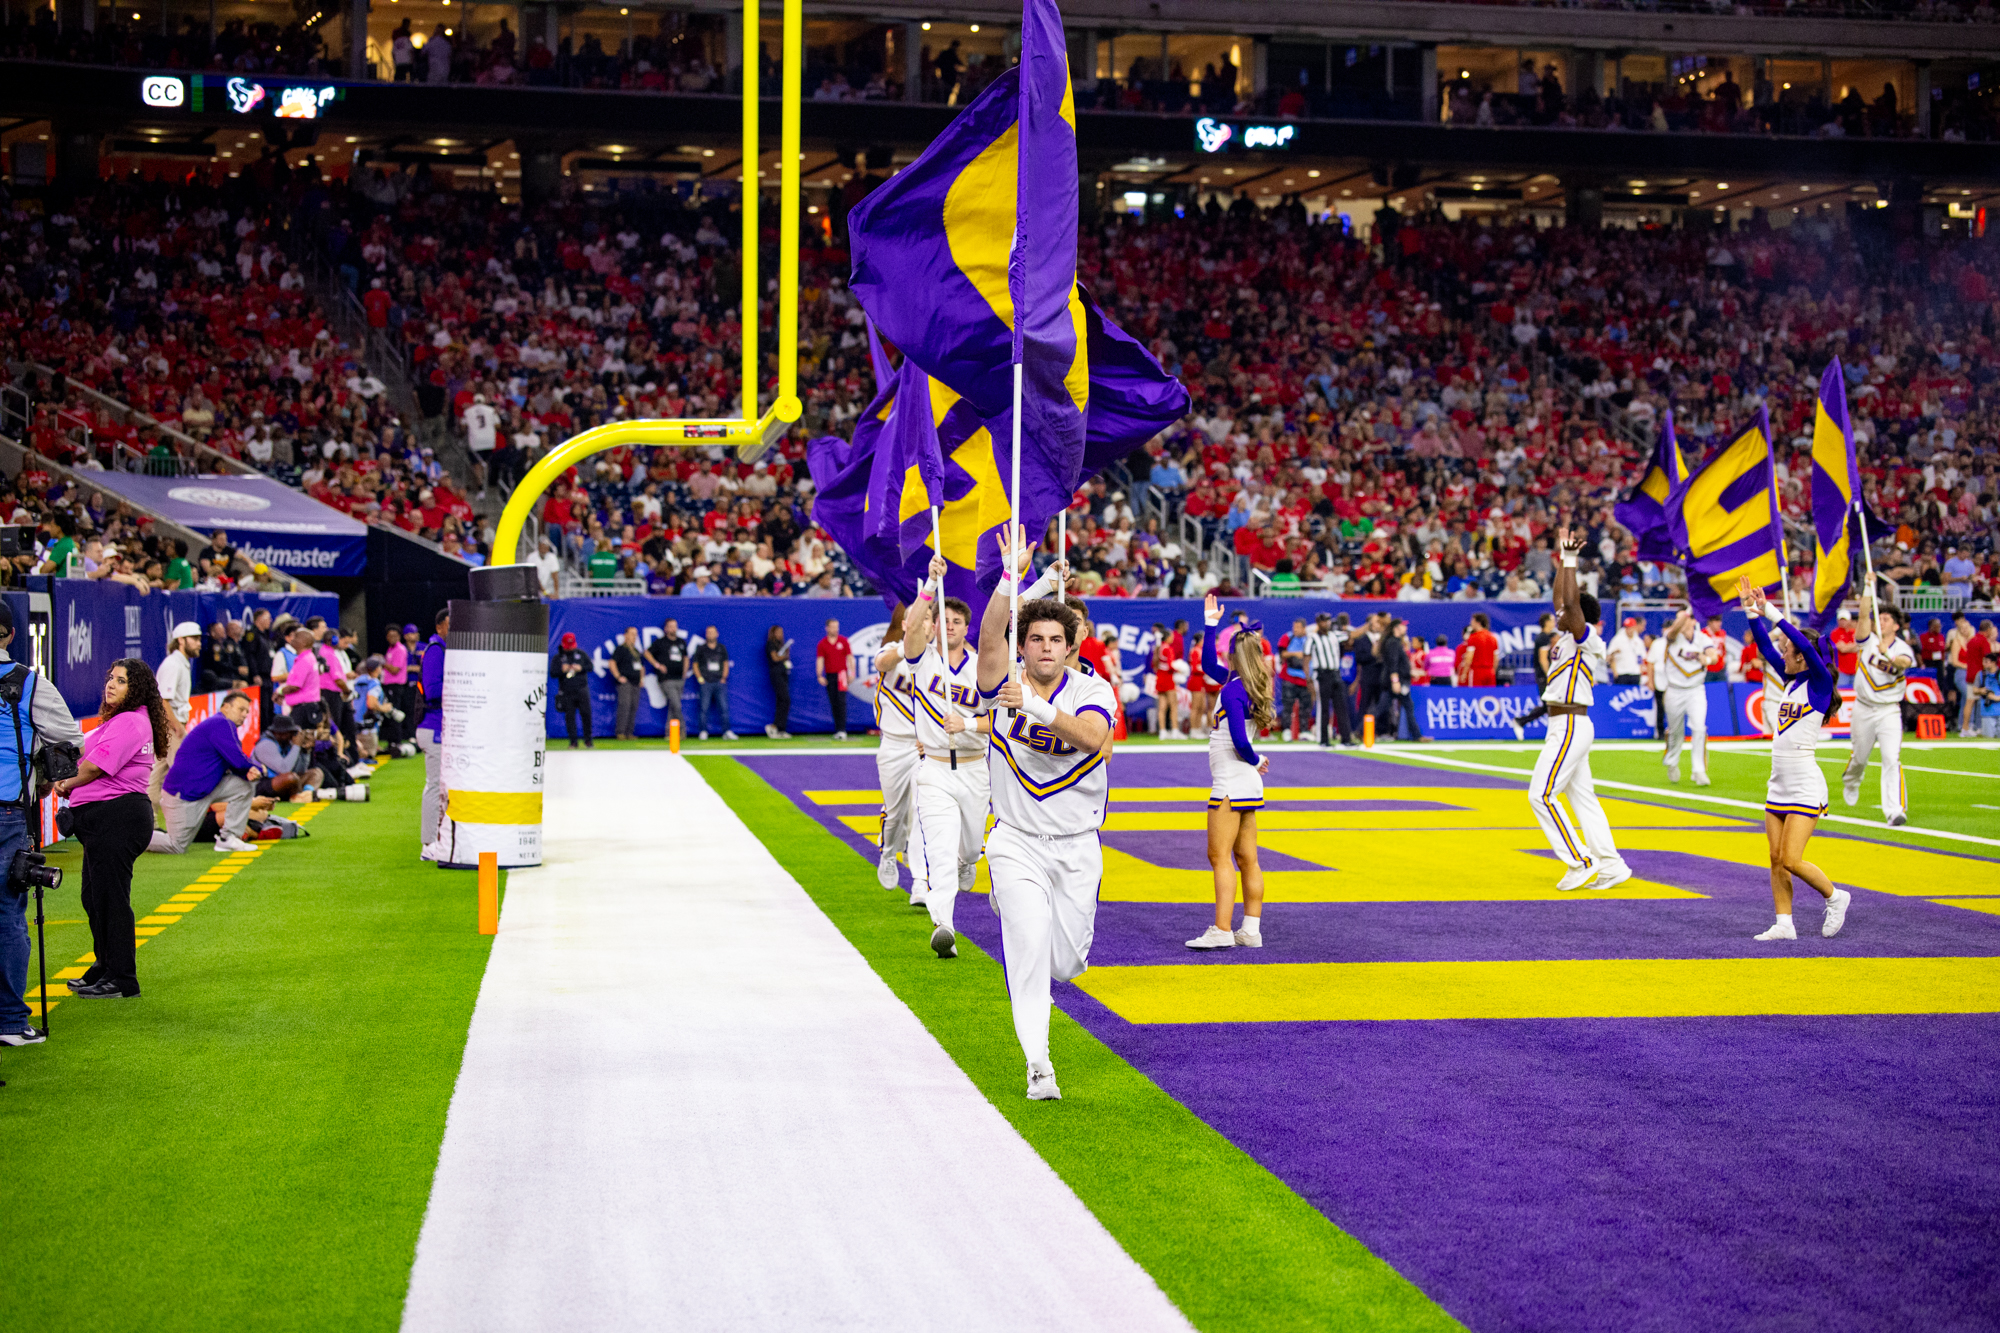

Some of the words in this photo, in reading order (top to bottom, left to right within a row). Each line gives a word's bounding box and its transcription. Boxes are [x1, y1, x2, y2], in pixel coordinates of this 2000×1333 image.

[148, 83, 177, 101] CC
[524, 683, 547, 711] KIN
[928, 673, 981, 709] LSU
[1609, 685, 1654, 711] KIND
[1427, 695, 1544, 717] MEMORIA
[1007, 712, 1079, 757] LSU
[1924, 718, 1942, 737] 10
